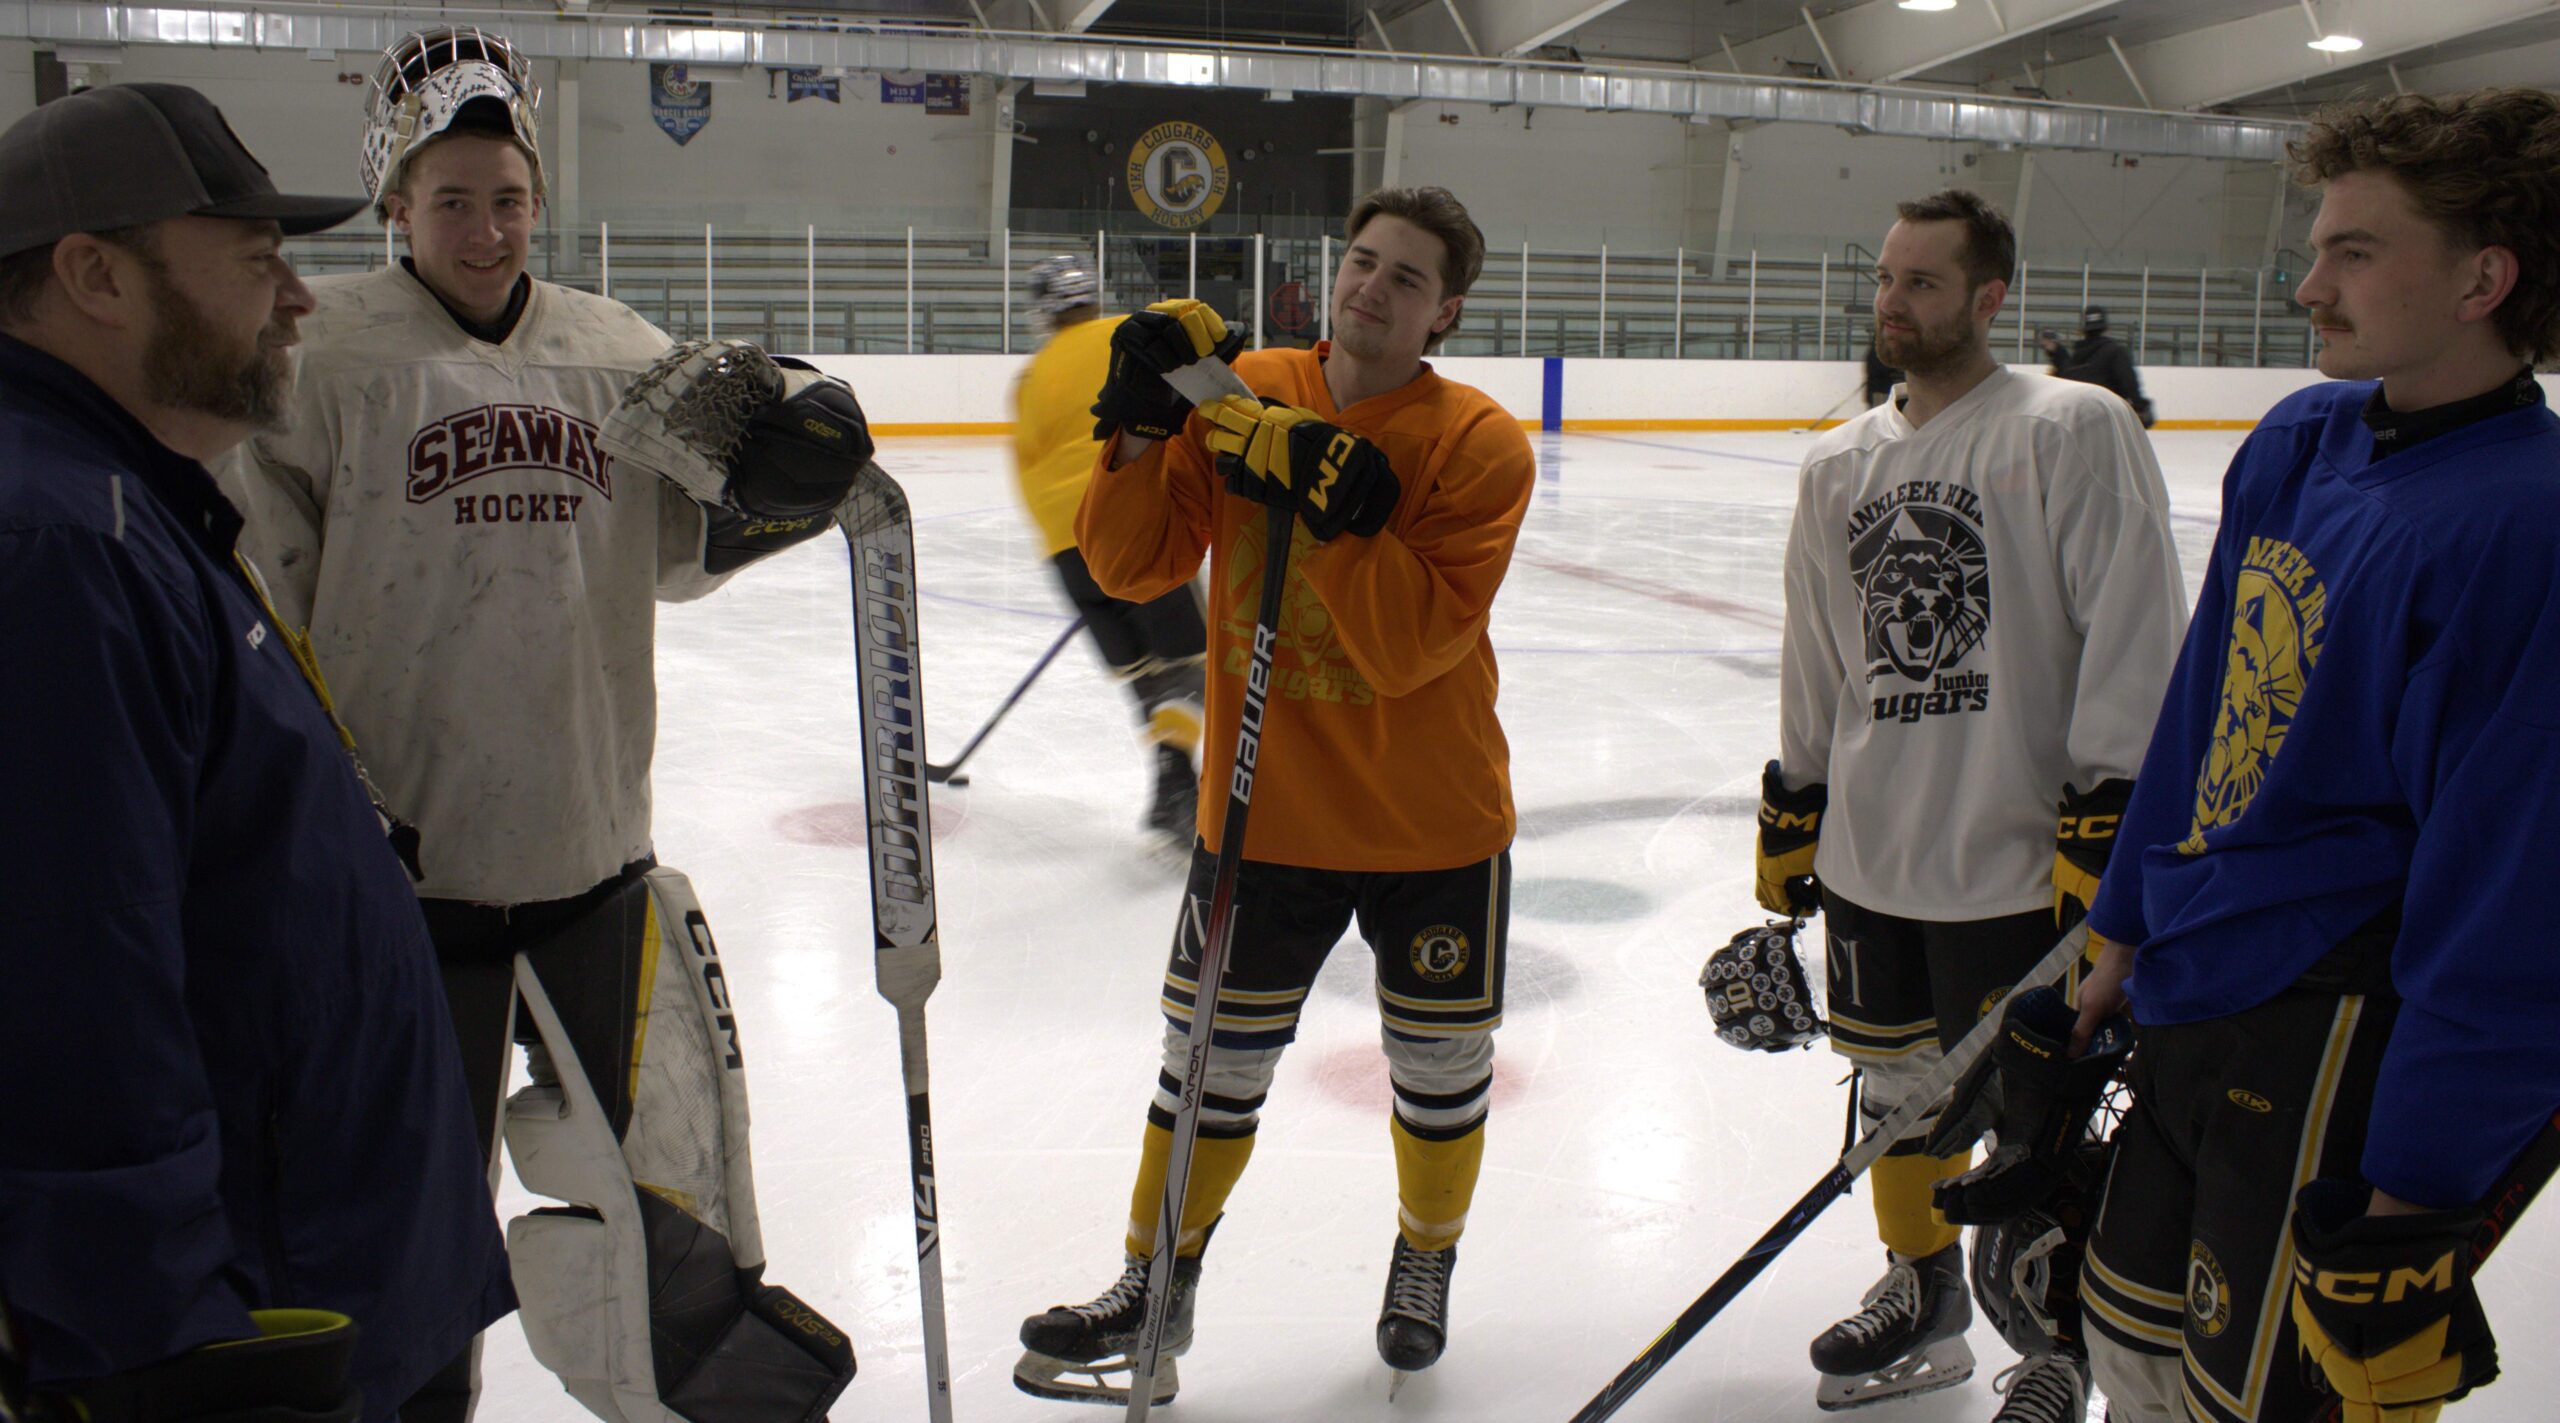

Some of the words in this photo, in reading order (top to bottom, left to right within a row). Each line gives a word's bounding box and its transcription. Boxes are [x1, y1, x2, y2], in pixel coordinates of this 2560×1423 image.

[1142, 123, 1214, 150] COUGARS
[1130, 162, 1142, 192] VKH
[1213, 165, 1226, 196] VKH
[1151, 207, 1206, 228] HOCKEY
[1135, 423, 1169, 437] CCM
[406, 403, 615, 503] SEAWAY
[1307, 428, 1361, 513] CM
[455, 494, 583, 525] HOCKEY
[1848, 480, 1942, 542] ANKLEEK
[1223, 645, 1374, 706] Cugars
[1318, 660, 1366, 683] Juni
[1873, 689, 1989, 723] ugars
[864, 546, 924, 905] WARRIOR
[1760, 799, 1819, 832] CM
[2056, 814, 2120, 839] CC
[685, 909, 743, 1070] CCM
[2010, 1030, 2052, 1059] CCM
[1180, 1040, 1206, 1113] VAPOR
[919, 1123, 932, 1166] PRO
[2294, 1247, 2456, 1305] CCM
